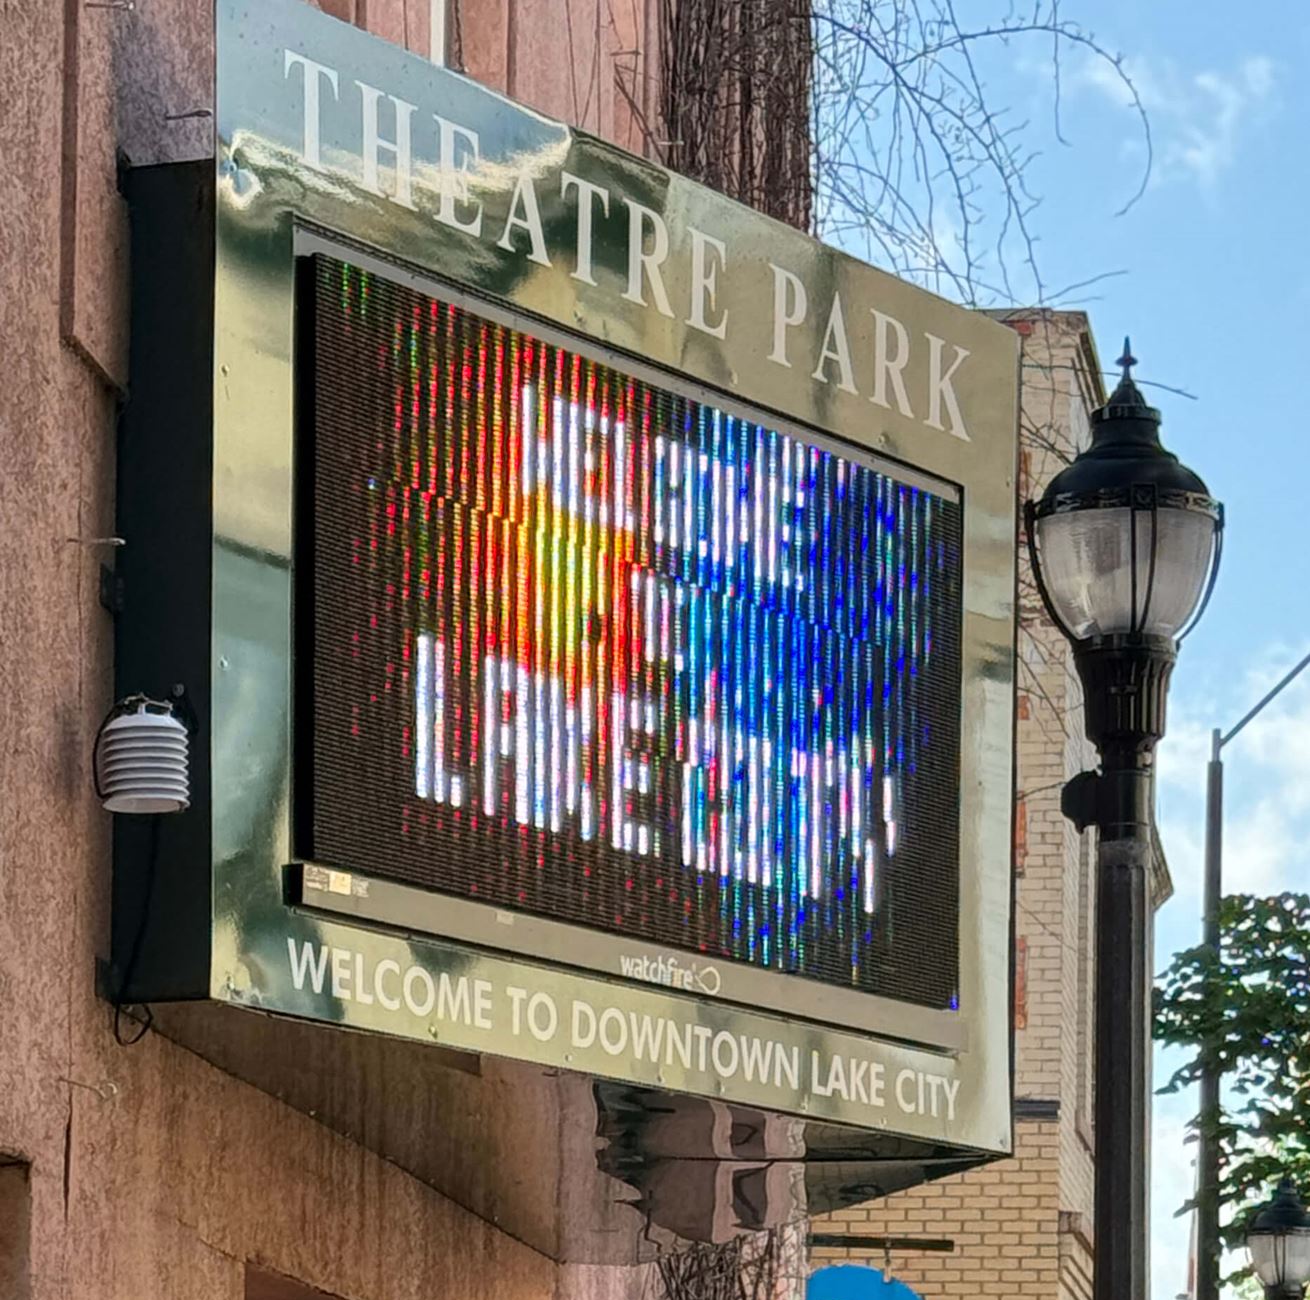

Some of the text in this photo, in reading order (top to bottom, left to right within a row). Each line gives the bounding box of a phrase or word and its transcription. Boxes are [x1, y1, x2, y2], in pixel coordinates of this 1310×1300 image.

[284, 49, 972, 442] THEATRE PARK
[415, 634, 662, 857] LAKE
[287, 936, 961, 1121] WELCOME TO DOWNTOWN LAKE CITY
[620, 955, 694, 991] watchfire
